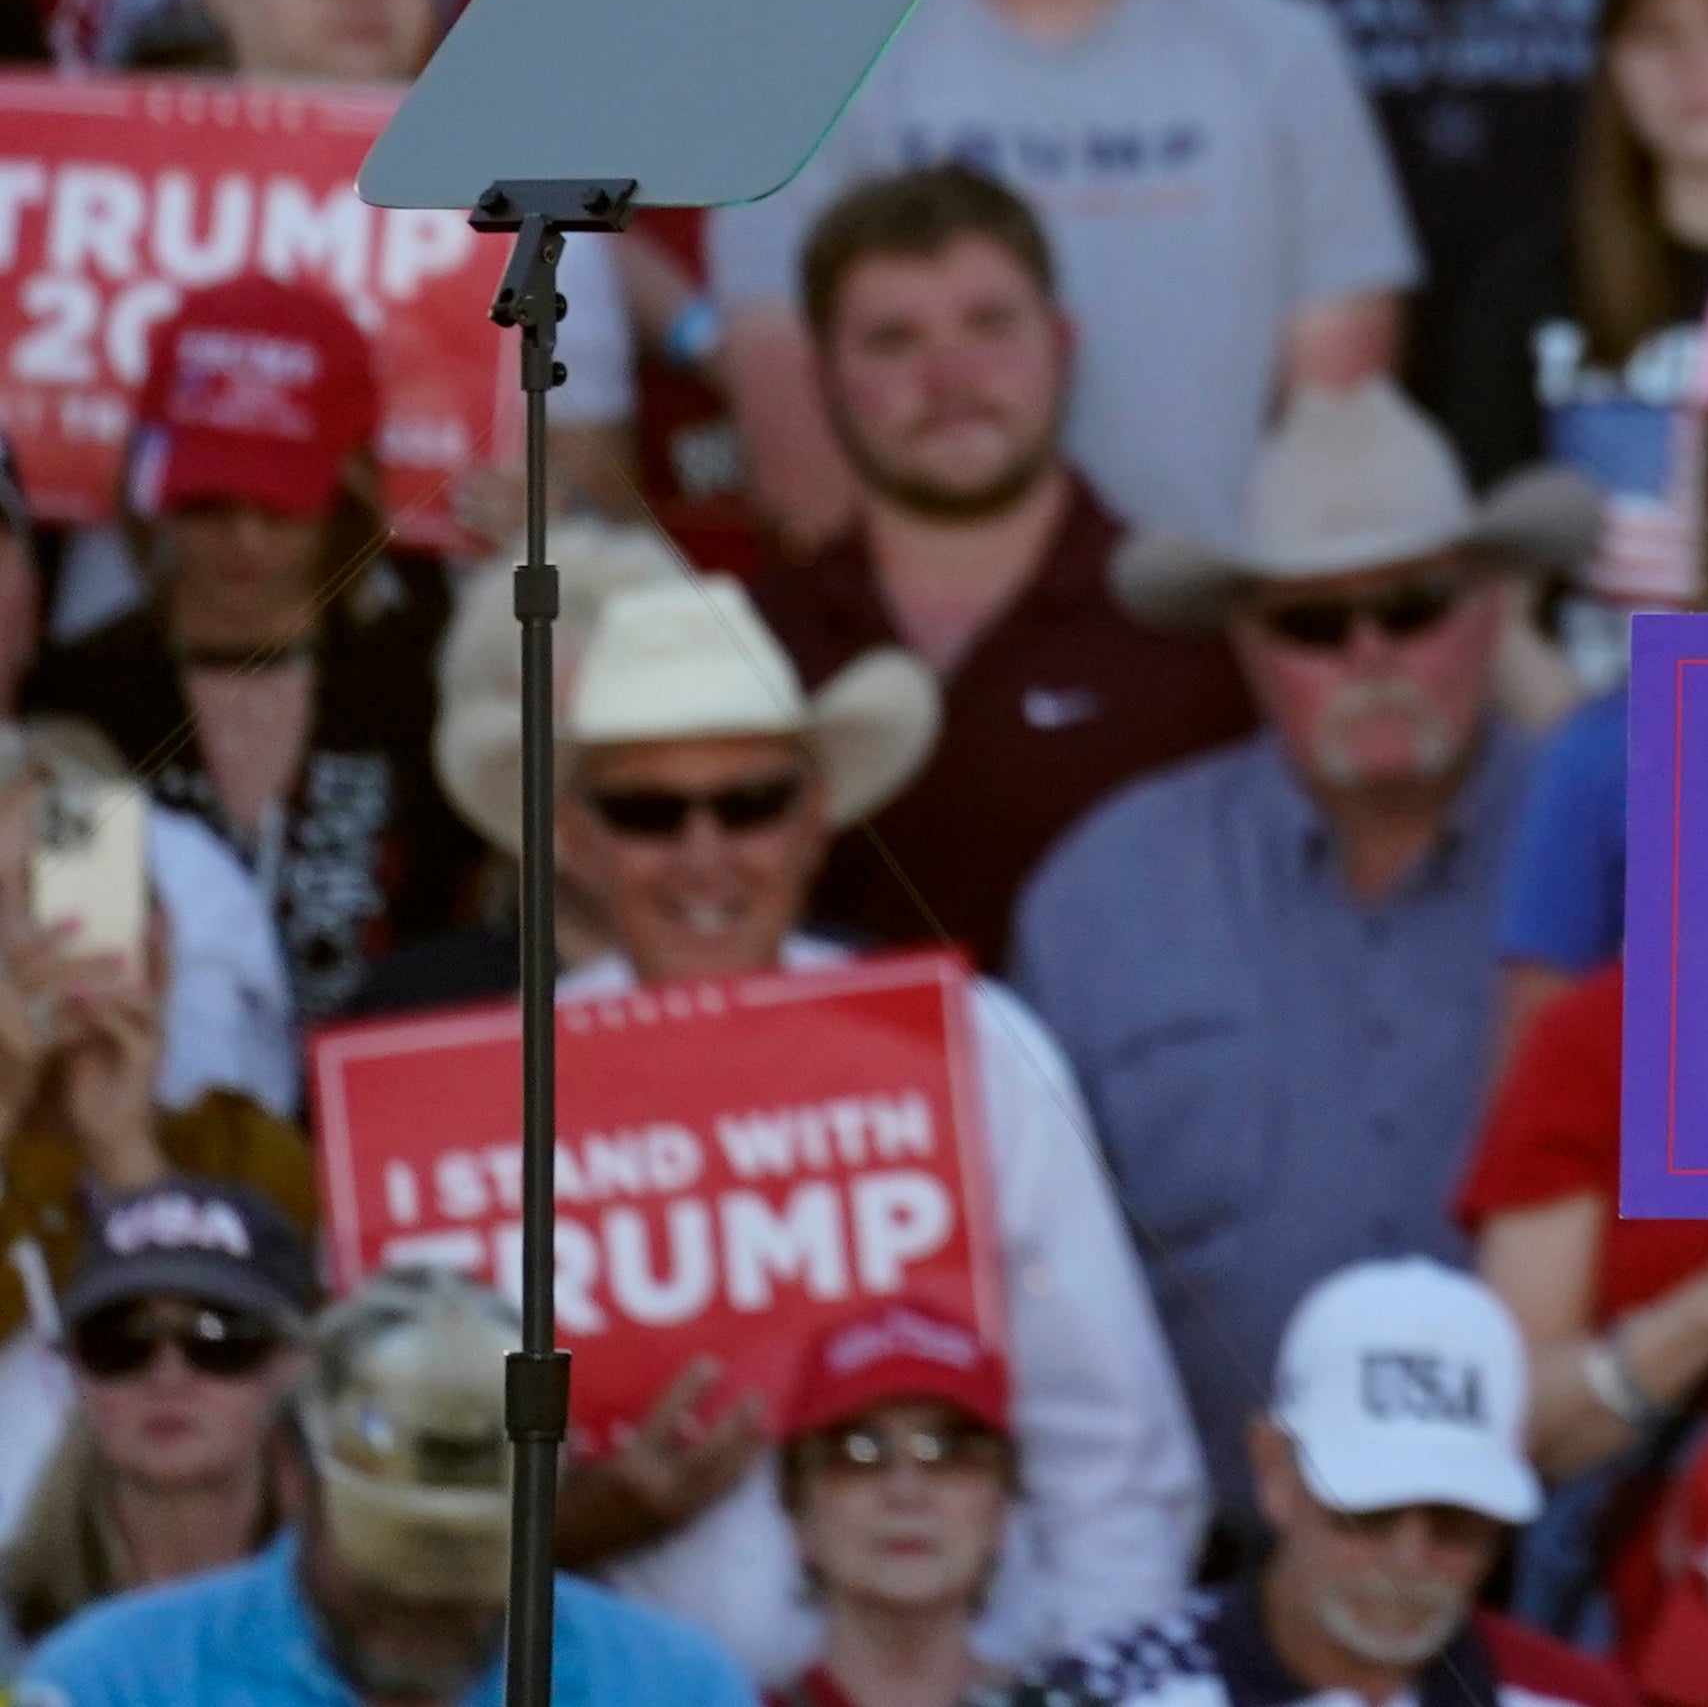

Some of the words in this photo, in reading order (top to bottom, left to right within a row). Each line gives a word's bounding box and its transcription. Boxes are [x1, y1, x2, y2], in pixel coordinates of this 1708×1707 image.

[384, 1156, 421, 1228] I
[716, 1090, 934, 1178] WITH
[1360, 1350, 1492, 1428] USA
